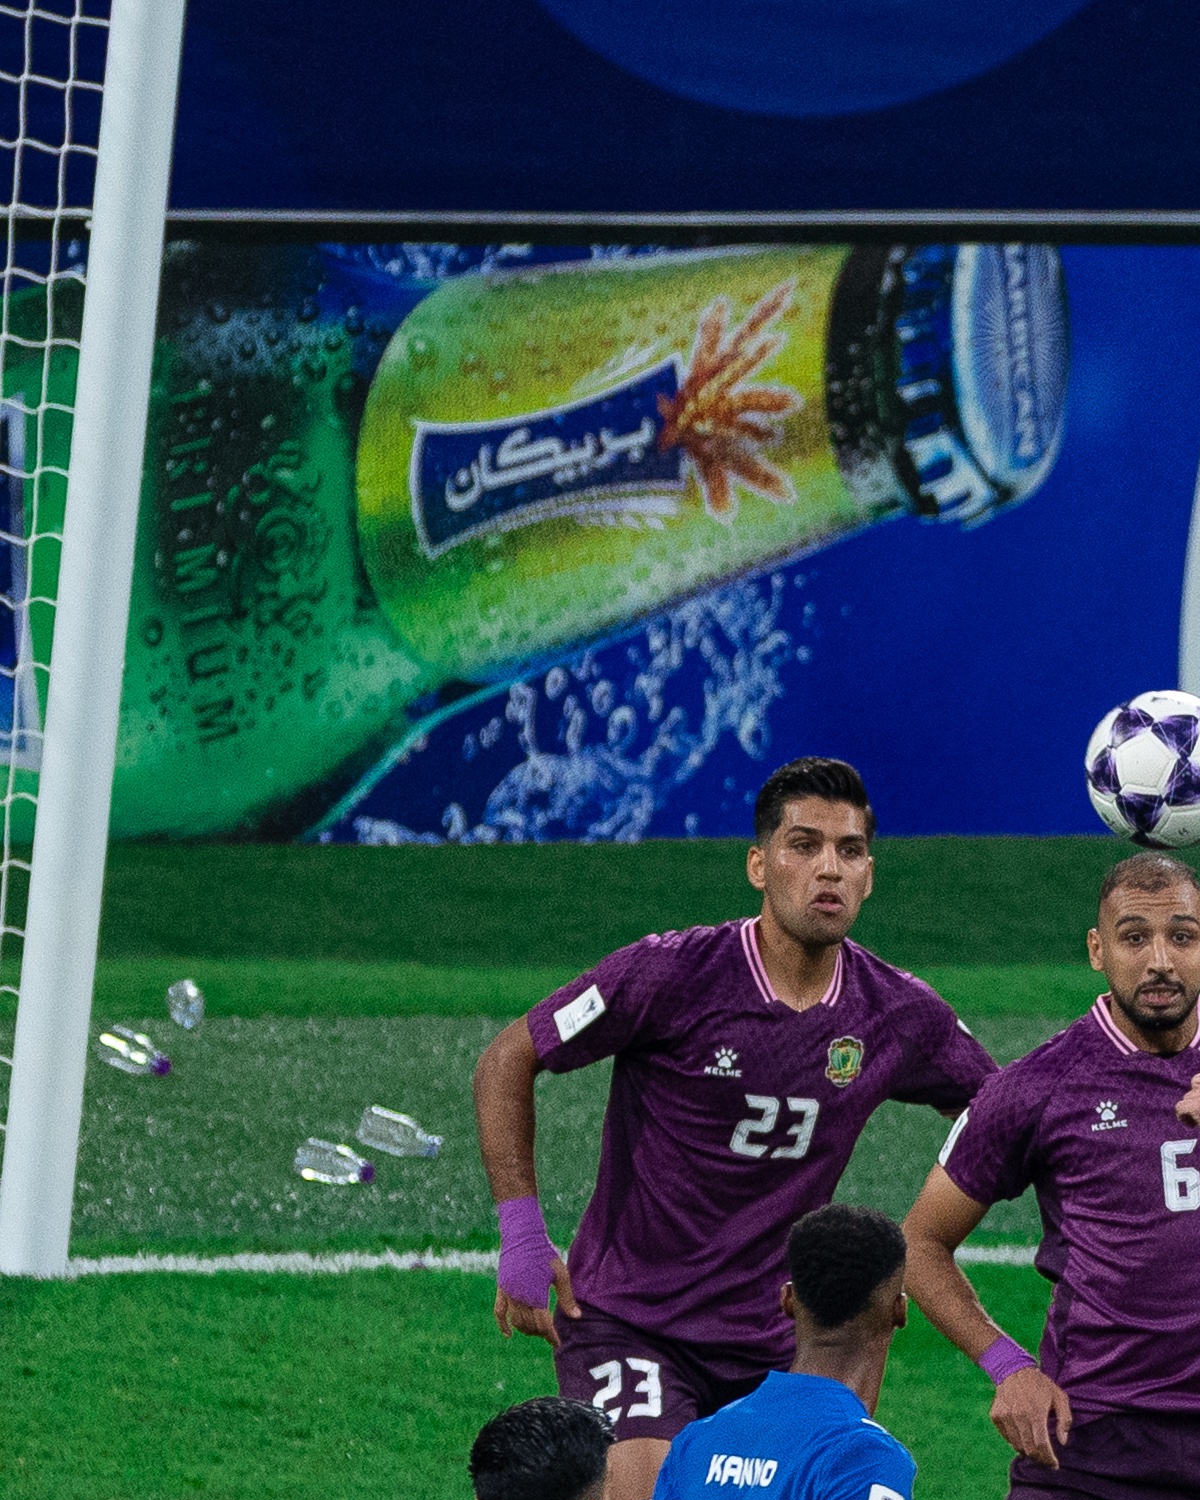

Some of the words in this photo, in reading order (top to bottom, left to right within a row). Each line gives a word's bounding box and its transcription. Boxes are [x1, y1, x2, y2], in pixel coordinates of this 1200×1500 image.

[445, 416, 656, 511] بربيكان
[704, 1066, 742, 1078] KELME
[729, 1094, 820, 1159] 23
[1091, 1119, 1128, 1132] KELME
[589, 1357, 663, 1423] 23
